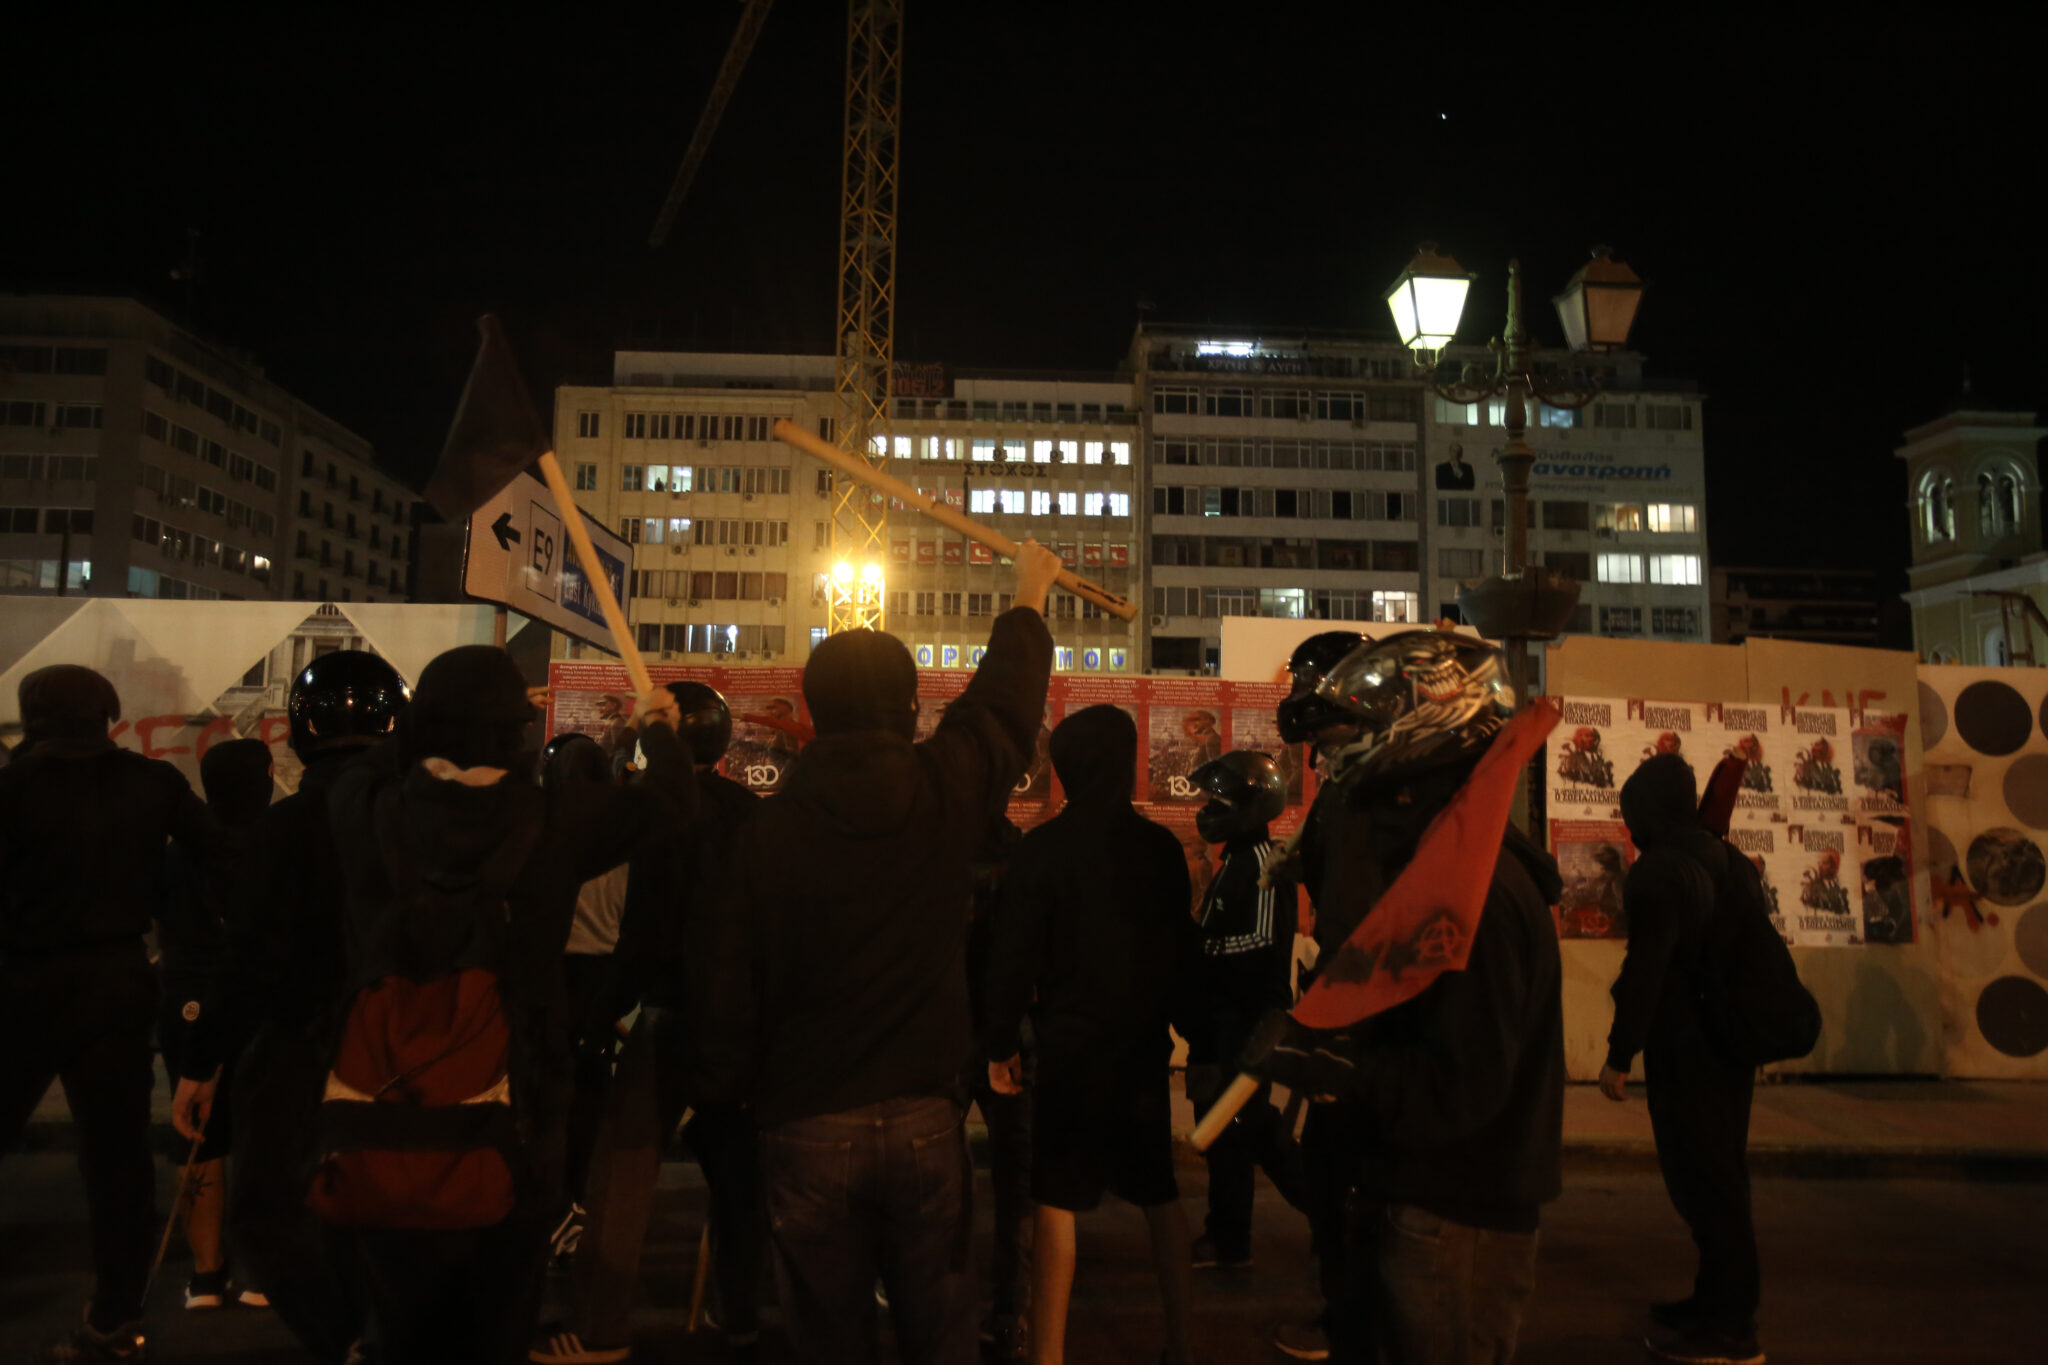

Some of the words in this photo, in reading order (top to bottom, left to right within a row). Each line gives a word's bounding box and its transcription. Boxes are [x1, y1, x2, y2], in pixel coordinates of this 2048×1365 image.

[964, 462, 1047, 478] ΣΤΟΧΟΣ
[1532, 462, 1671, 480] ανατροπή
[533, 528, 553, 575] E9
